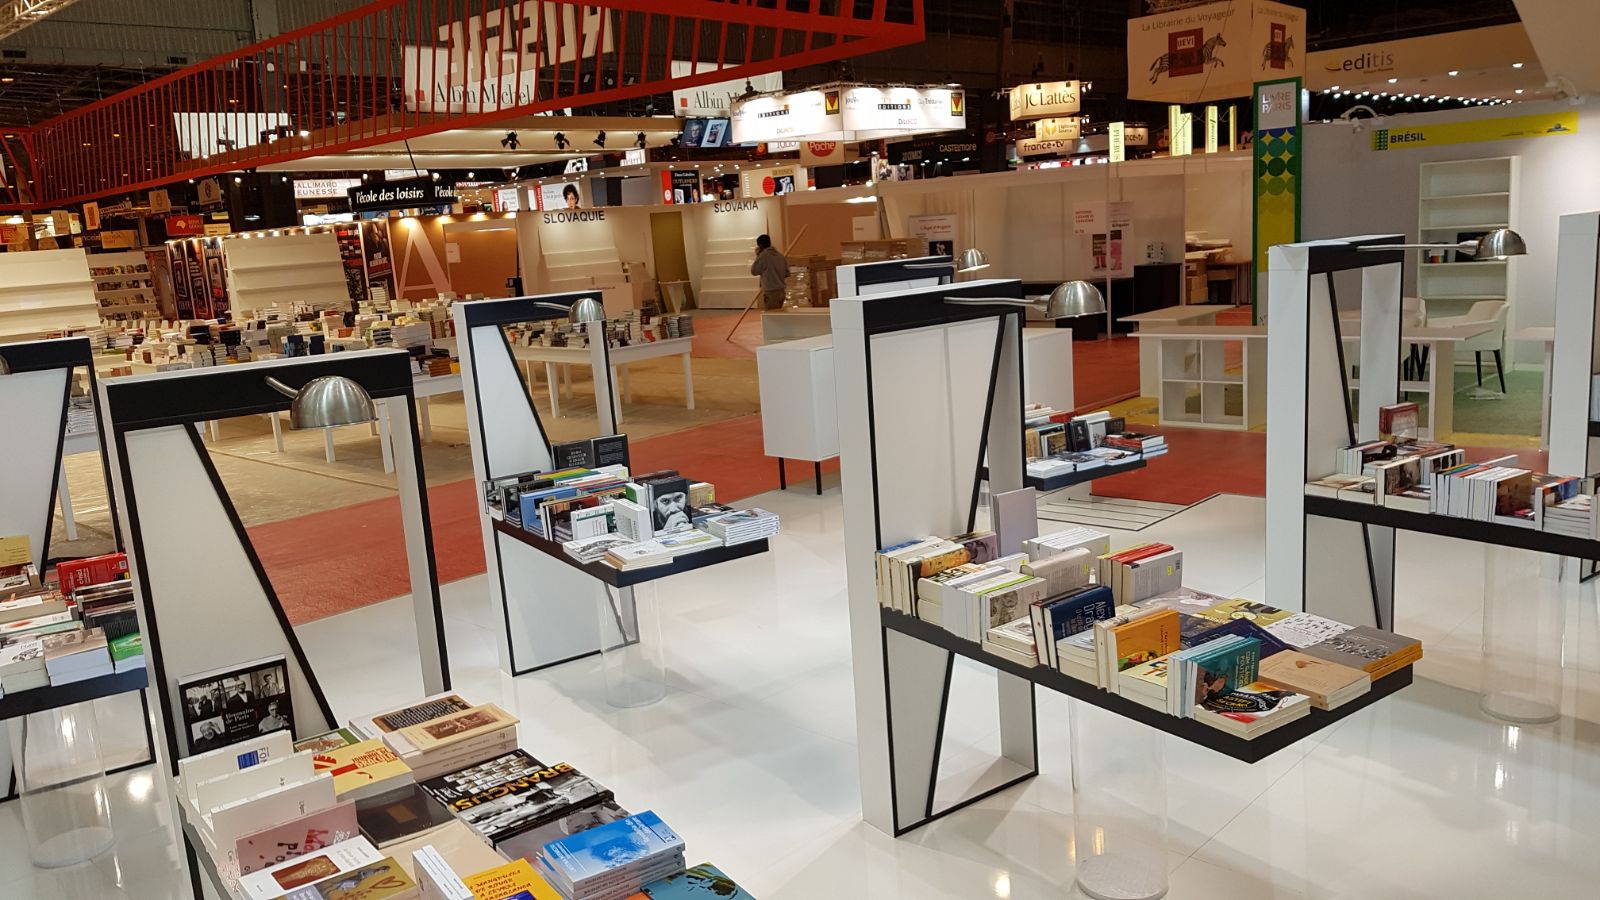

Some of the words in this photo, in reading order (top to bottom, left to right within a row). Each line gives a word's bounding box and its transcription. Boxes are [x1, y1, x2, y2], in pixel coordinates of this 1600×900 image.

[1152, 18, 1183, 30] Librairie
[1186, 14, 1195, 24] du
[1198, 8, 1235, 23] Voyageur
[1343, 51, 1394, 71] editis
[435, 82, 476, 104] Albn
[483, 83, 531, 105] Mchel
[693, 91, 724, 109] Albin
[1390, 130, 1426, 144] BRÉSIL
[294, 181, 338, 189] ALLIMARD
[296, 188, 338, 196] EUNESSE
[379, 188, 395, 201] des
[396, 187, 424, 200] loisirs
[713, 200, 759, 214] SLOVAKIA
[543, 210, 606, 224] SLOVAQUIE
[1095, 601, 1107, 620] Alex
